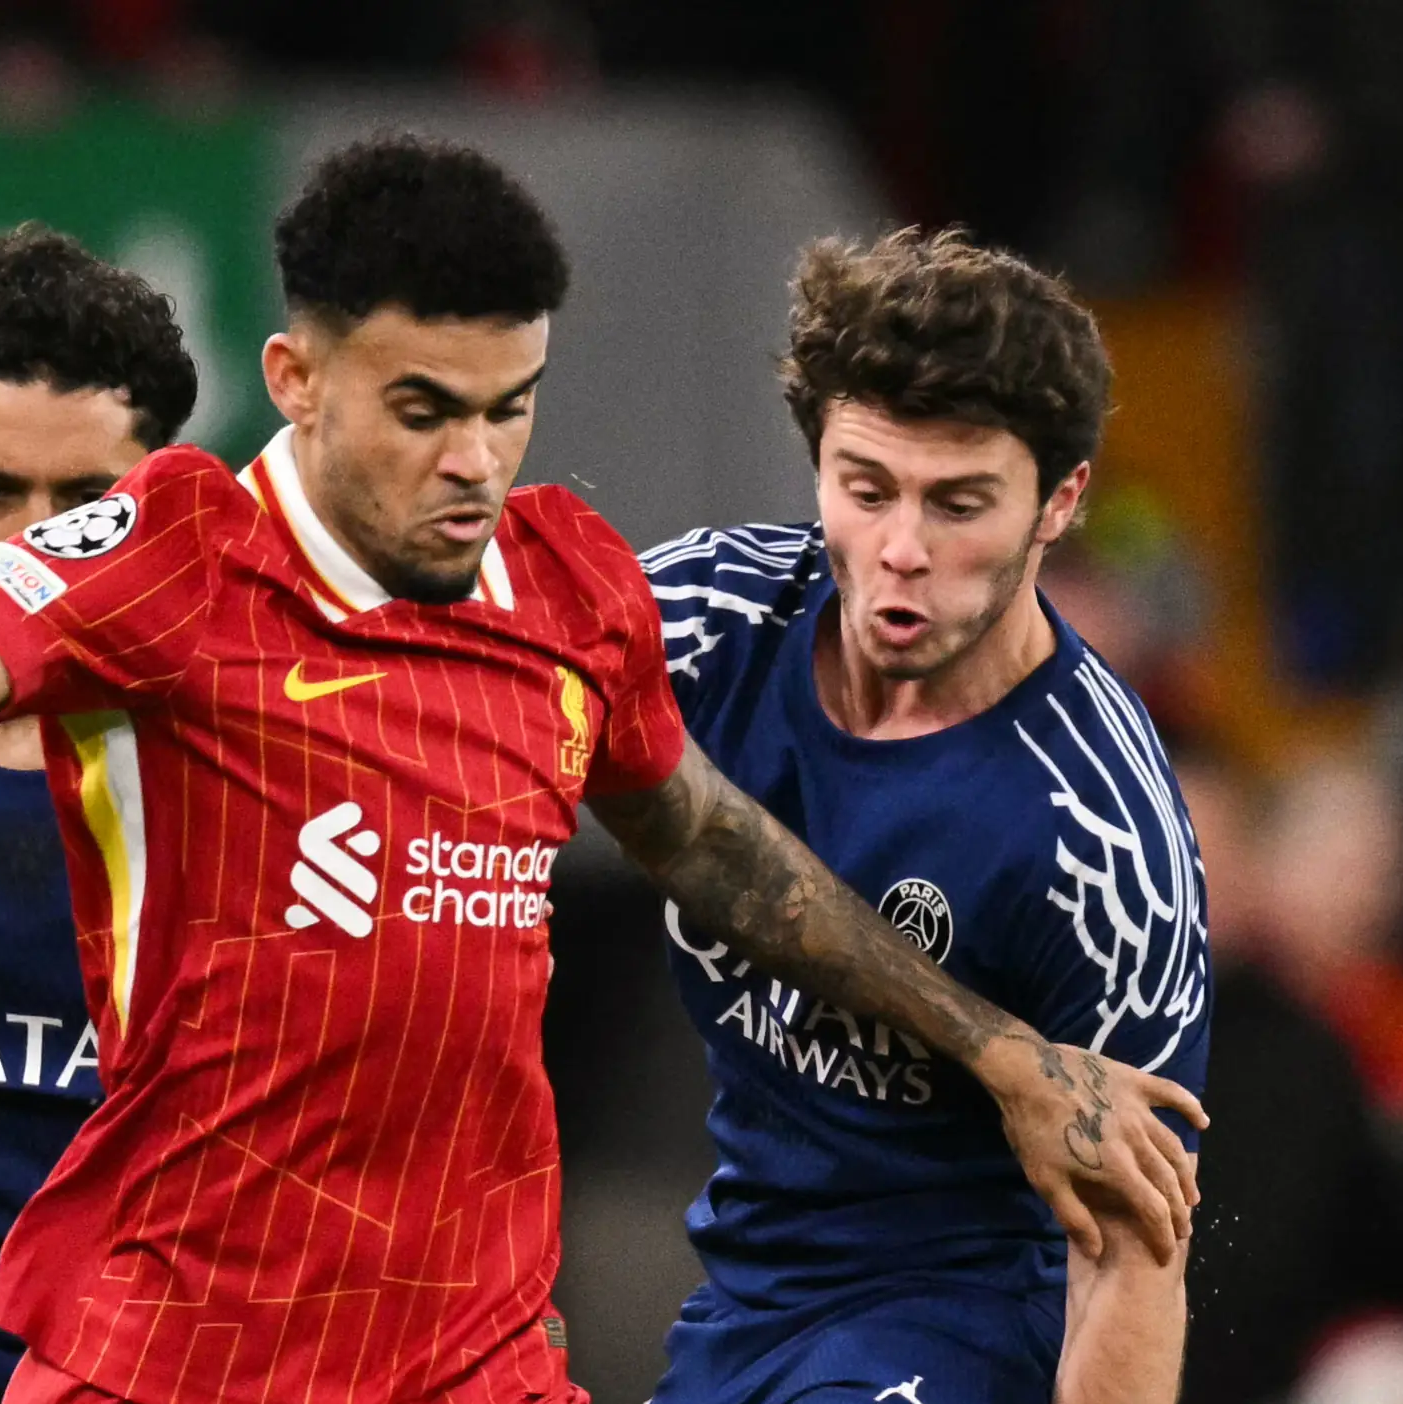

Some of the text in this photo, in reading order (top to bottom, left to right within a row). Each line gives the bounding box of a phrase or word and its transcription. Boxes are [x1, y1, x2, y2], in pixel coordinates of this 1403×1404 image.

[405, 831, 558, 883] standa
[899, 883, 946, 917] PARIS
[715, 990, 932, 1104] AIRWAYS
